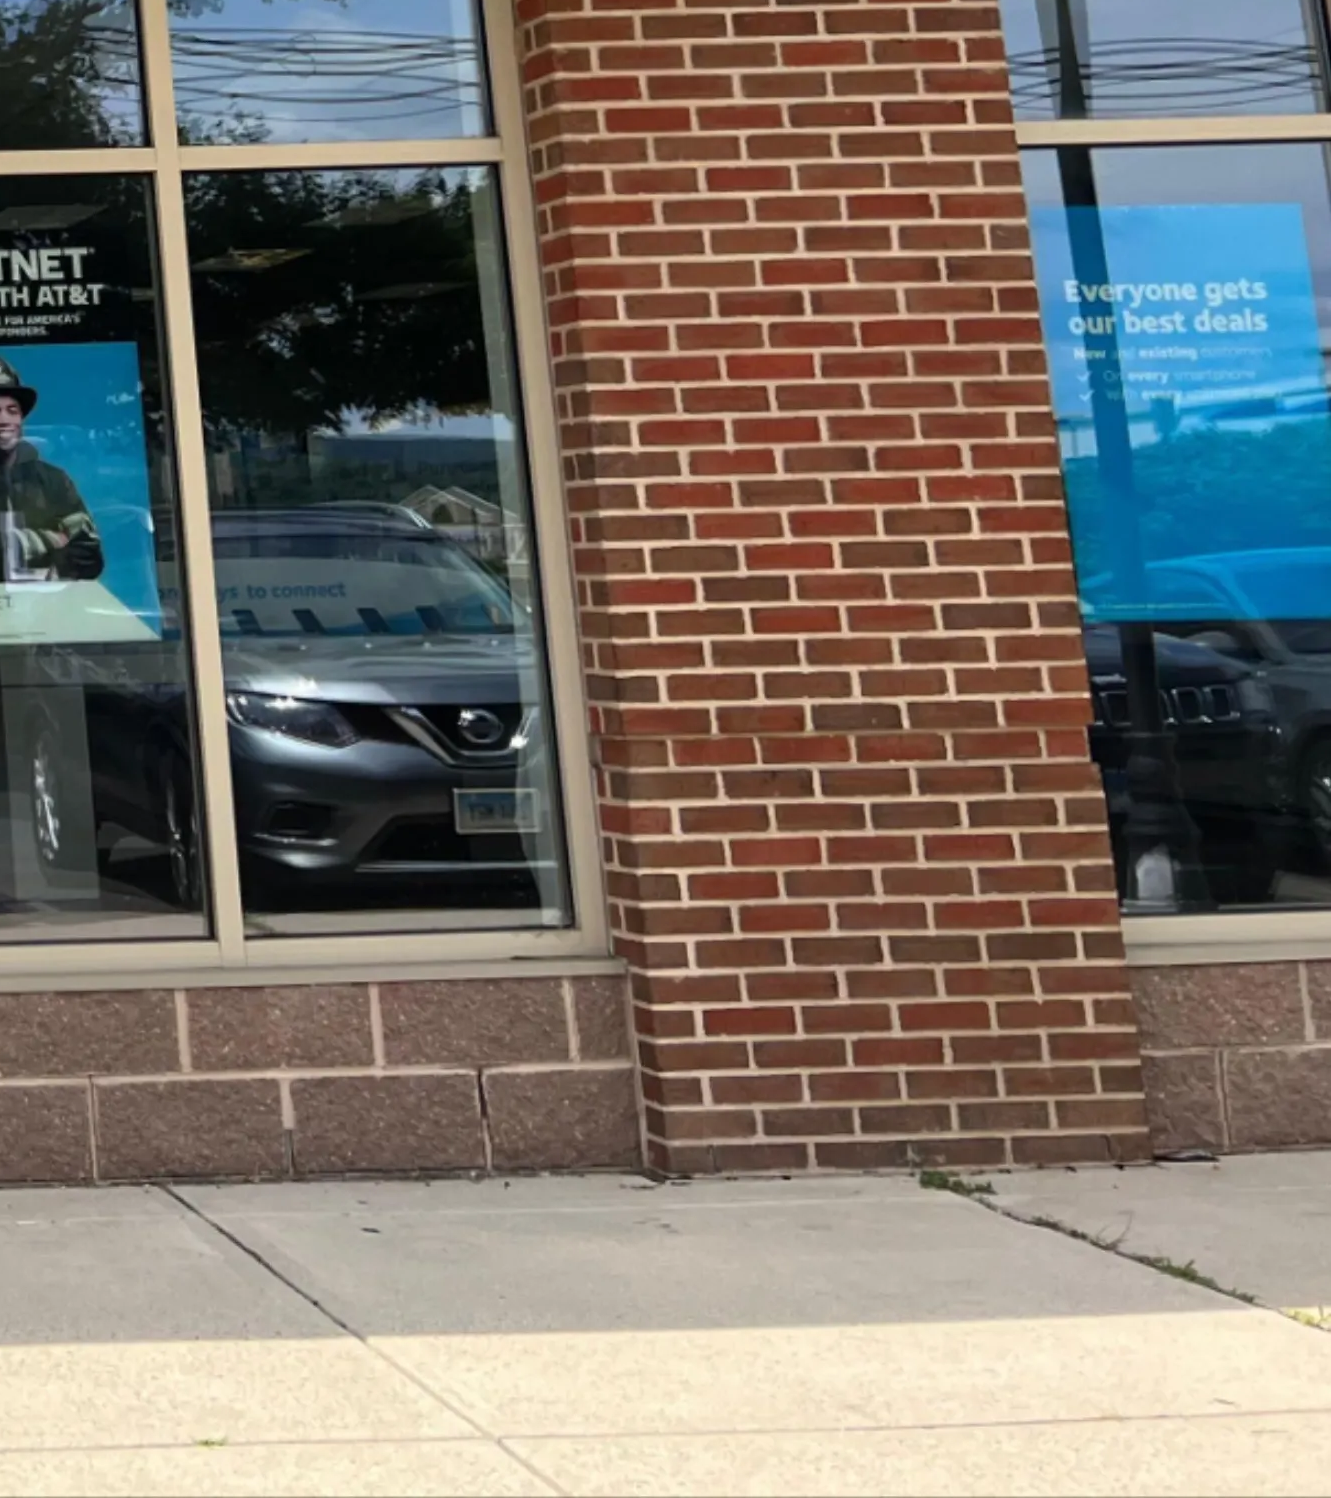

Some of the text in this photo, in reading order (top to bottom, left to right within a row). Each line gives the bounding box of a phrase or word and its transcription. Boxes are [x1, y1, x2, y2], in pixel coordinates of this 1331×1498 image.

[36, 283, 104, 306] AT&T
[1064, 277, 1268, 308] Everyone gets
[1068, 307, 1268, 335] our best deals
[1138, 346, 1199, 361] existing
[1127, 371, 1169, 384] every
[246, 583, 268, 600] to
[271, 581, 347, 599] connect
